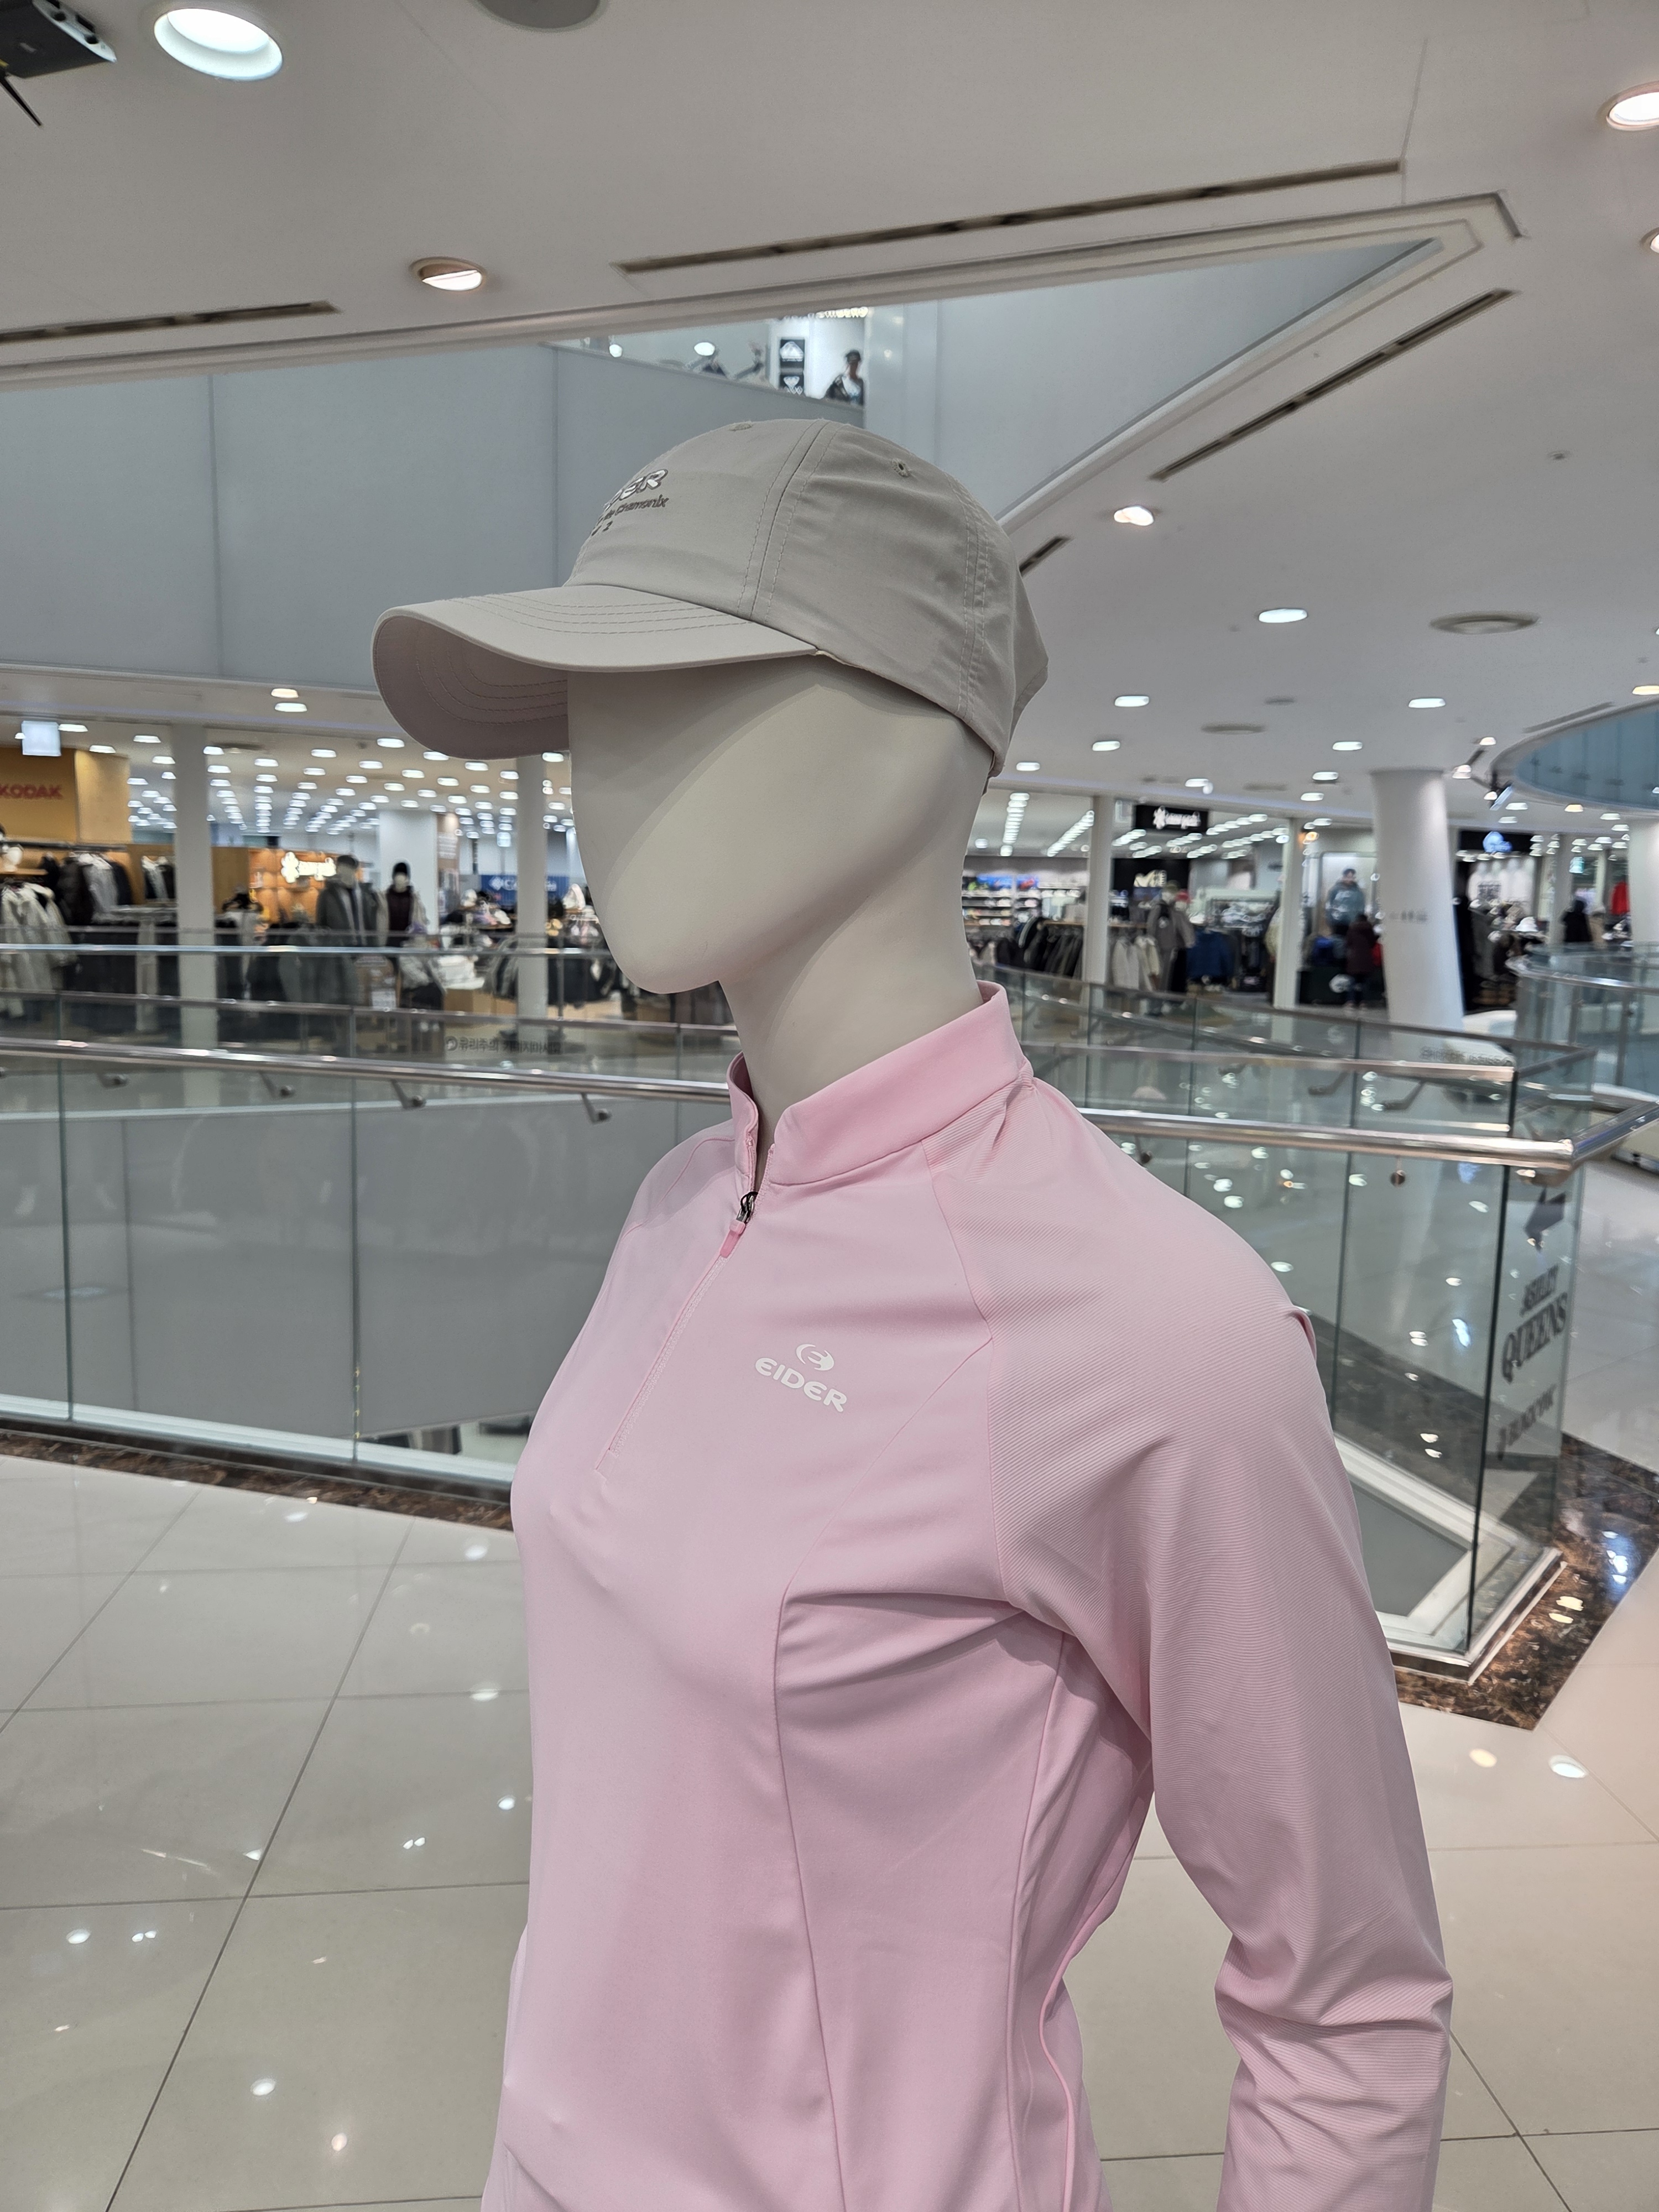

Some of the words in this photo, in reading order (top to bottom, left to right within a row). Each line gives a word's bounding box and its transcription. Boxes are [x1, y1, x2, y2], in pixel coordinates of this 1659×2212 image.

[0, 784, 64, 800] KODAK
[1501, 1292, 1568, 1384] QUEENS
[755, 1357, 848, 1413] EIDER
